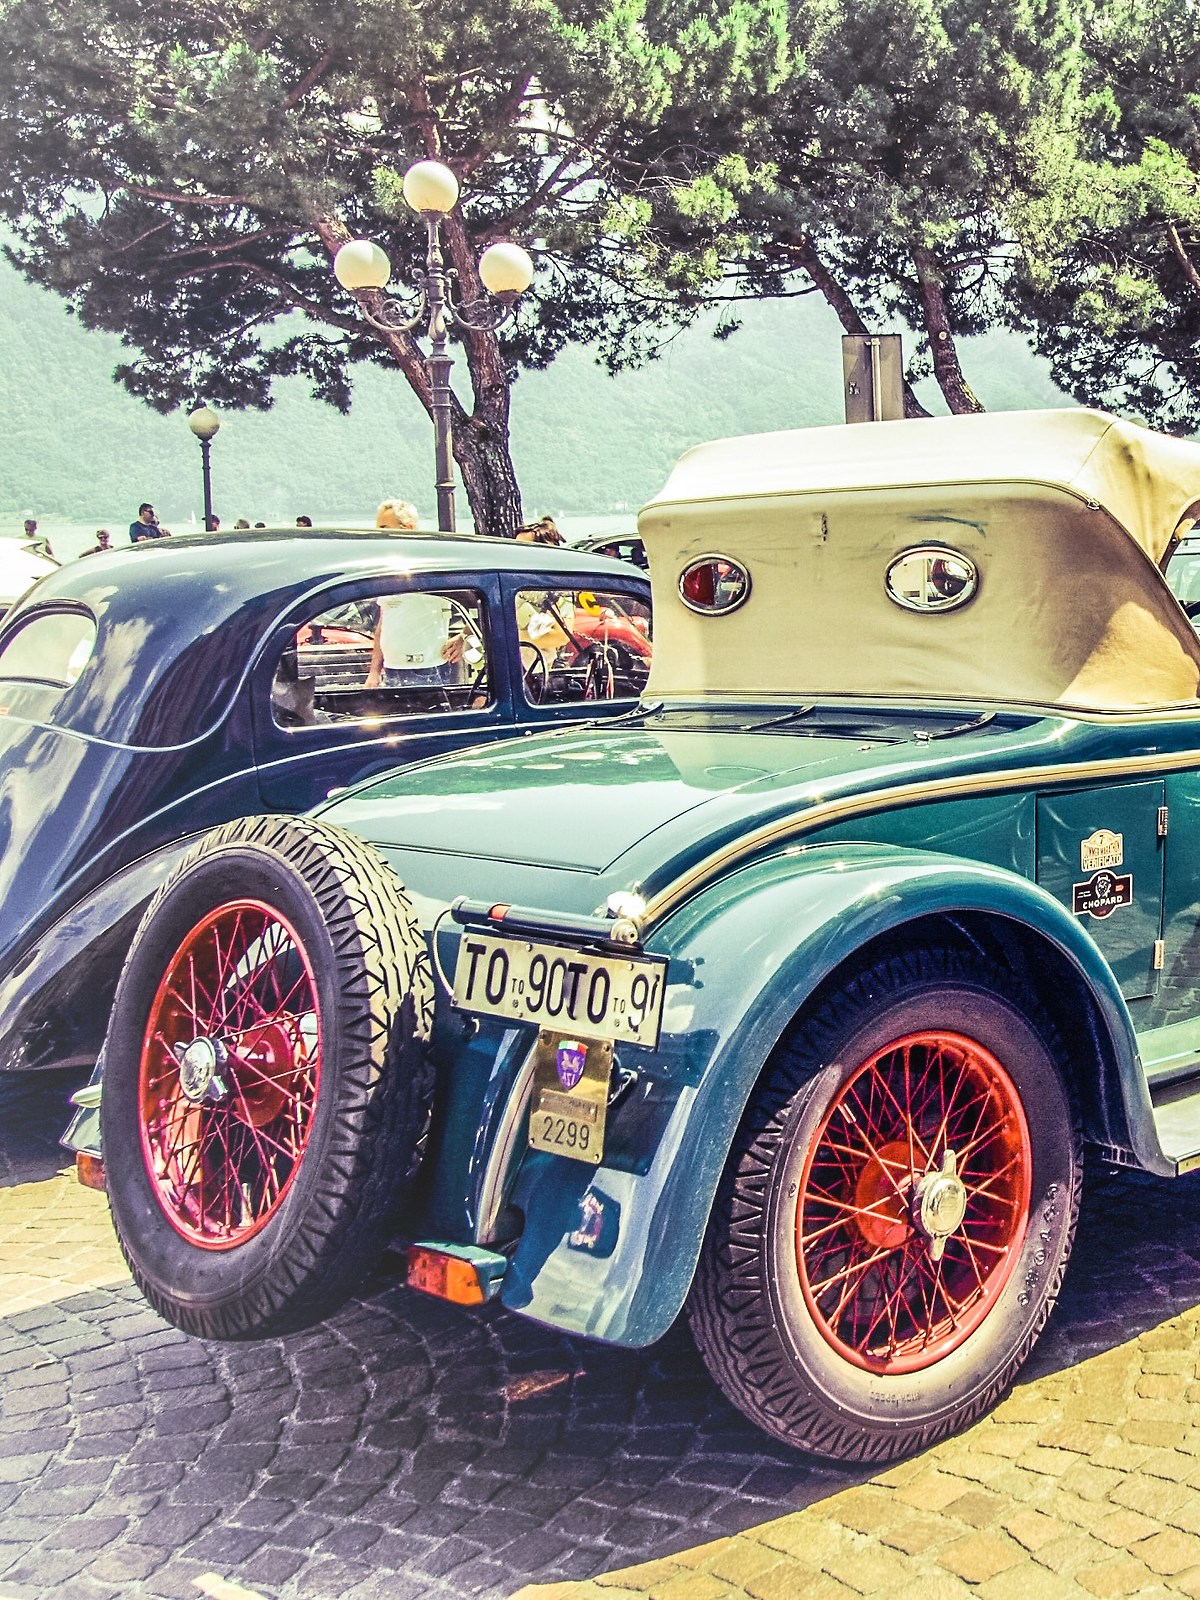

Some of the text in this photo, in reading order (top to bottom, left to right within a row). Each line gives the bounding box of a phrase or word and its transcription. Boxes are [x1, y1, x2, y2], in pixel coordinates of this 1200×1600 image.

[1082, 853, 1121, 870] VERIFICATO
[1082, 895, 1122, 910] CHOPARD
[465, 943, 509, 1005] TO
[542, 1115, 590, 1151] 2299
